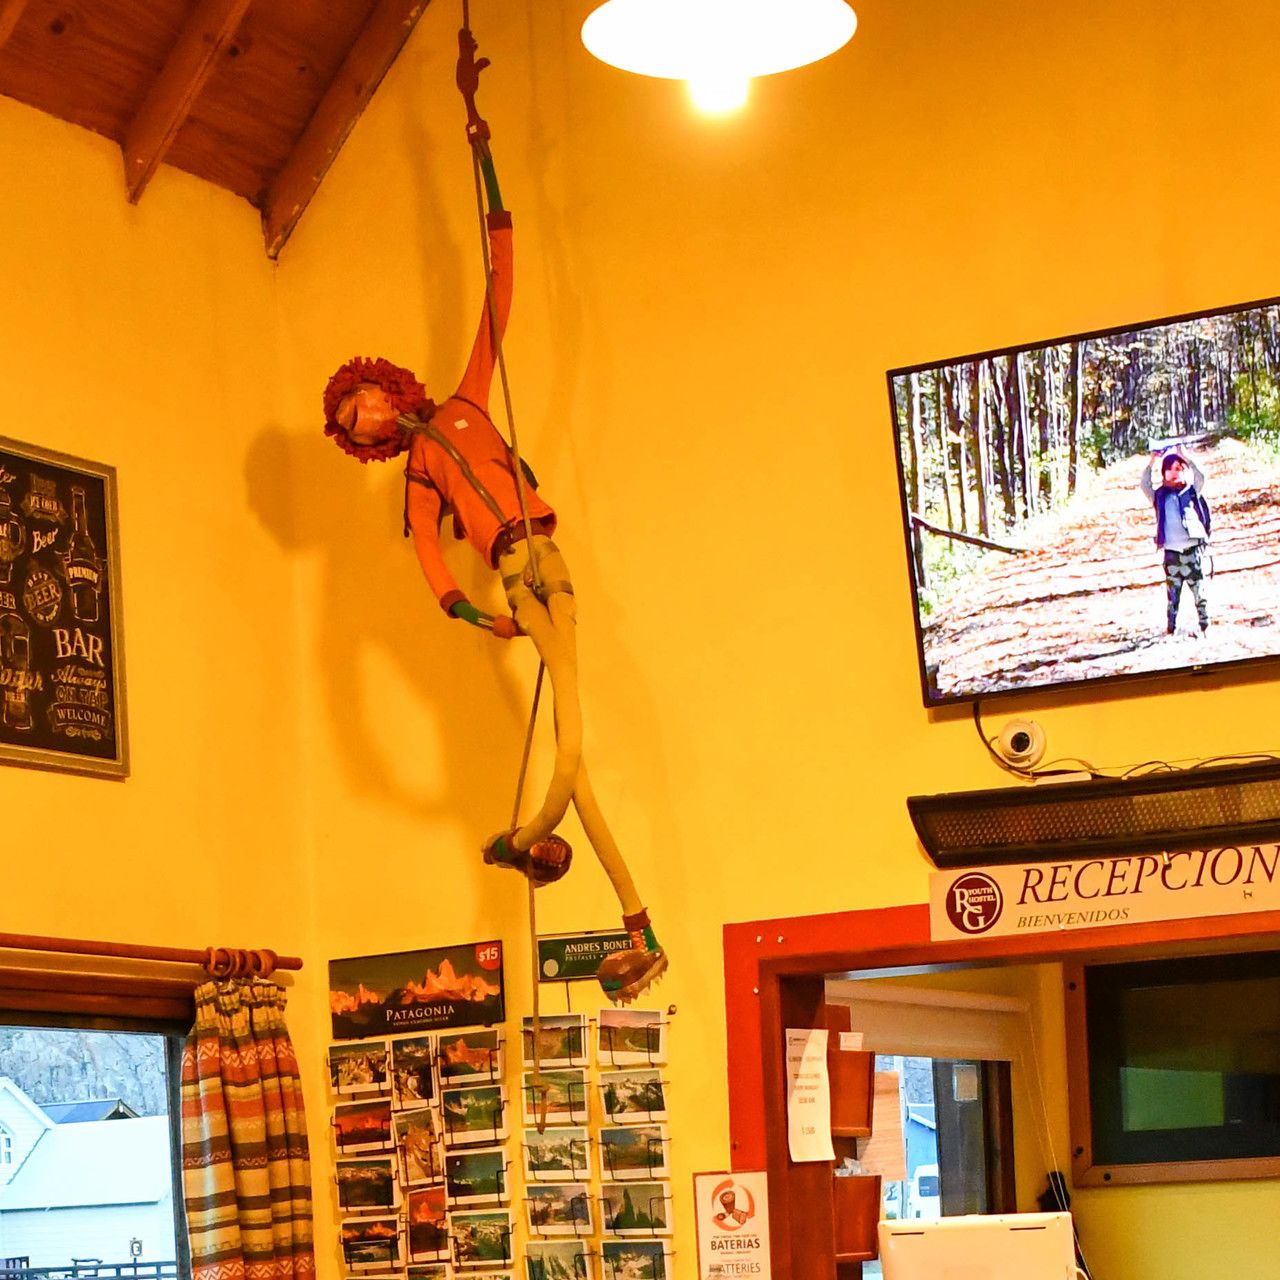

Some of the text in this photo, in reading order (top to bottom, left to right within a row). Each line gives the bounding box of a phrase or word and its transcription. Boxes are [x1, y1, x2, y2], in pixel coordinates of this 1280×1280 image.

[32, 528, 59, 553] Beer
[68, 566, 99, 585] PREMIUM
[52, 627, 106, 667] BAR
[57, 708, 107, 726] WELCOME
[968, 886, 994, 896] YOUTH
[1017, 906, 1131, 929] BIENVENIDOS
[478, 946, 499, 963] $15
[564, 942, 601, 954] ANDRES
[386, 1004, 455, 1022] PATAGONIA
[710, 1238, 761, 1251] BATERIAS
[709, 1262, 761, 1274] ATTERIES
